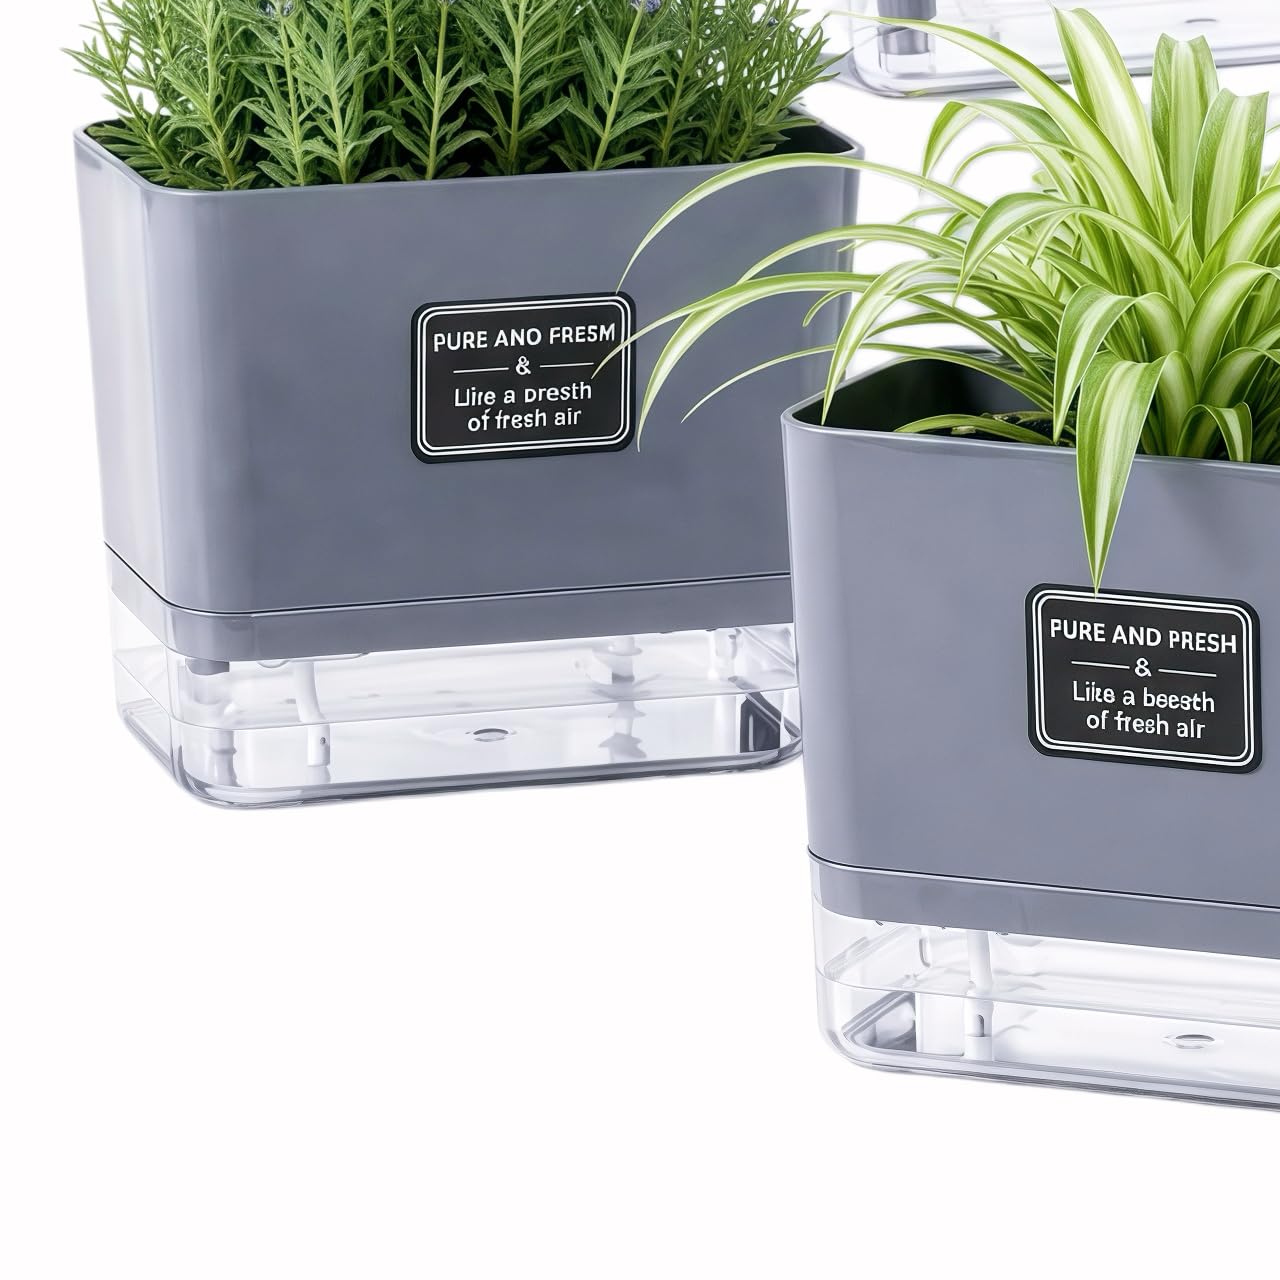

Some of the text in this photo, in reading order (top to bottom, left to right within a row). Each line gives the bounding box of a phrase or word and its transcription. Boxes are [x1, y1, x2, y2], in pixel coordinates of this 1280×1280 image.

[433, 331, 488, 353] PURE
[515, 355, 532, 376] &
[503, 389, 516, 404] a
[467, 407, 492, 432] of
[554, 407, 583, 426] air
[1050, 618, 1237, 654] PURE AND PRESH
[1134, 657, 1152, 678] &
[1122, 689, 1136, 706] a
[1086, 709, 1110, 730] of
